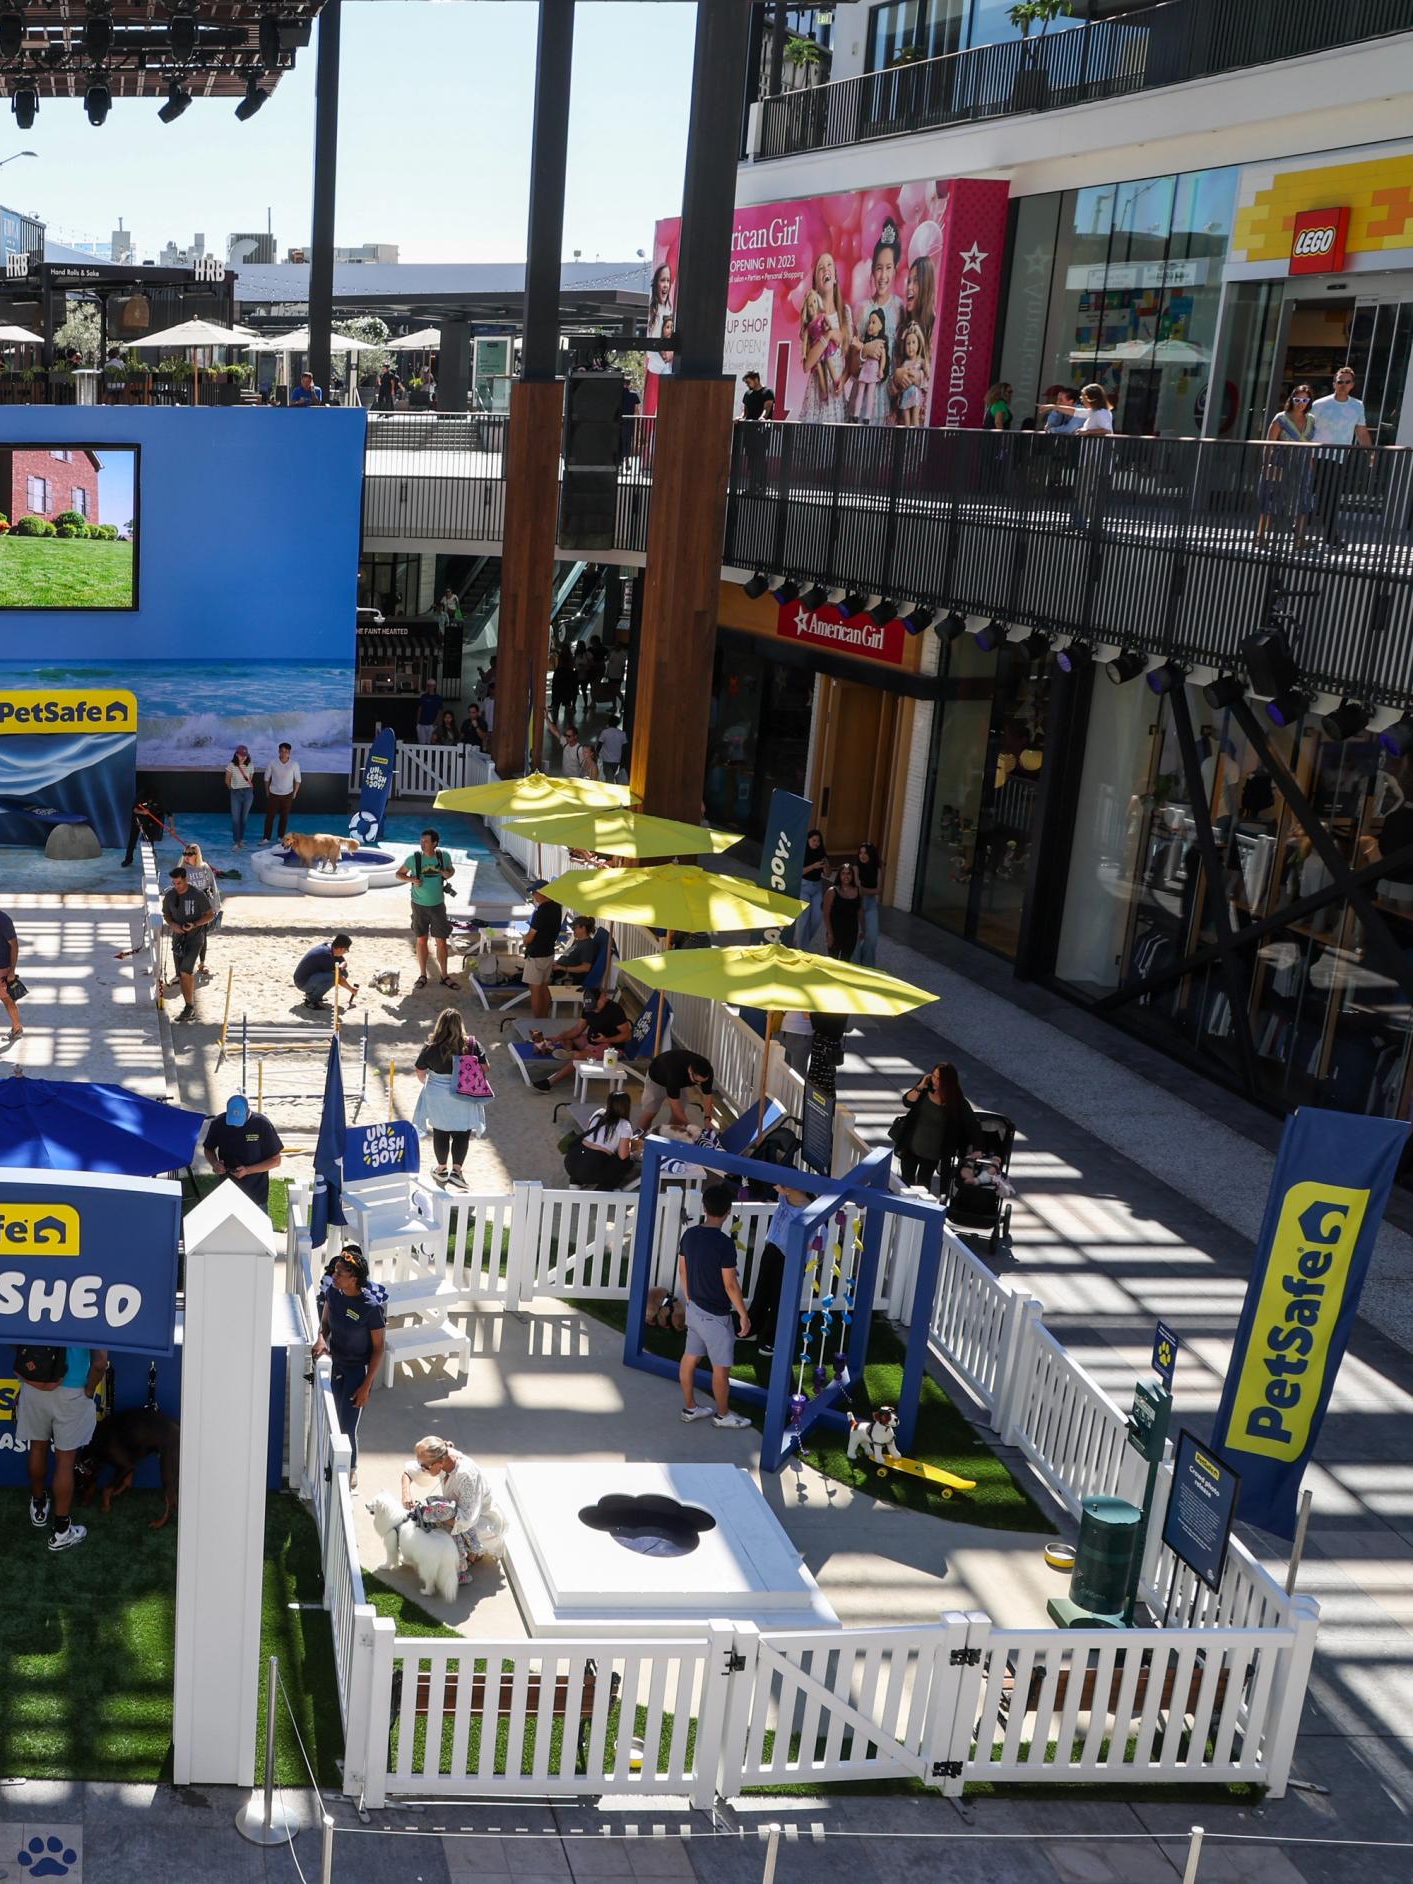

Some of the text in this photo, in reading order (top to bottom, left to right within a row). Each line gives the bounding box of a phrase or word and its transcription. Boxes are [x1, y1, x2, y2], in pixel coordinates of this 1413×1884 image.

[731, 215, 801, 251] rican Girl
[1294, 227, 1335, 256] LEGO
[5, 253, 29, 277] HRB
[50, 268, 99, 277] Hand Rolls & Sake
[195, 259, 225, 282] HRB
[730, 255, 795, 273] OPENING IN 2023
[783, 271, 804, 281] Shopping
[725, 318, 768, 334] -UP SHOP
[949, 279, 981, 393] American
[737, 339, 762, 353] OPEN
[808, 613, 885, 650] American Girl
[771, 831, 792, 891] JOY!
[366, 1123, 387, 1142] UN
[363, 1136, 405, 1155] LEASH
[372, 1149, 404, 1168] JOY!
[1245, 1250, 1333, 1445] PetSafe
[1189, 1465, 1220, 1497] Crowd photo
